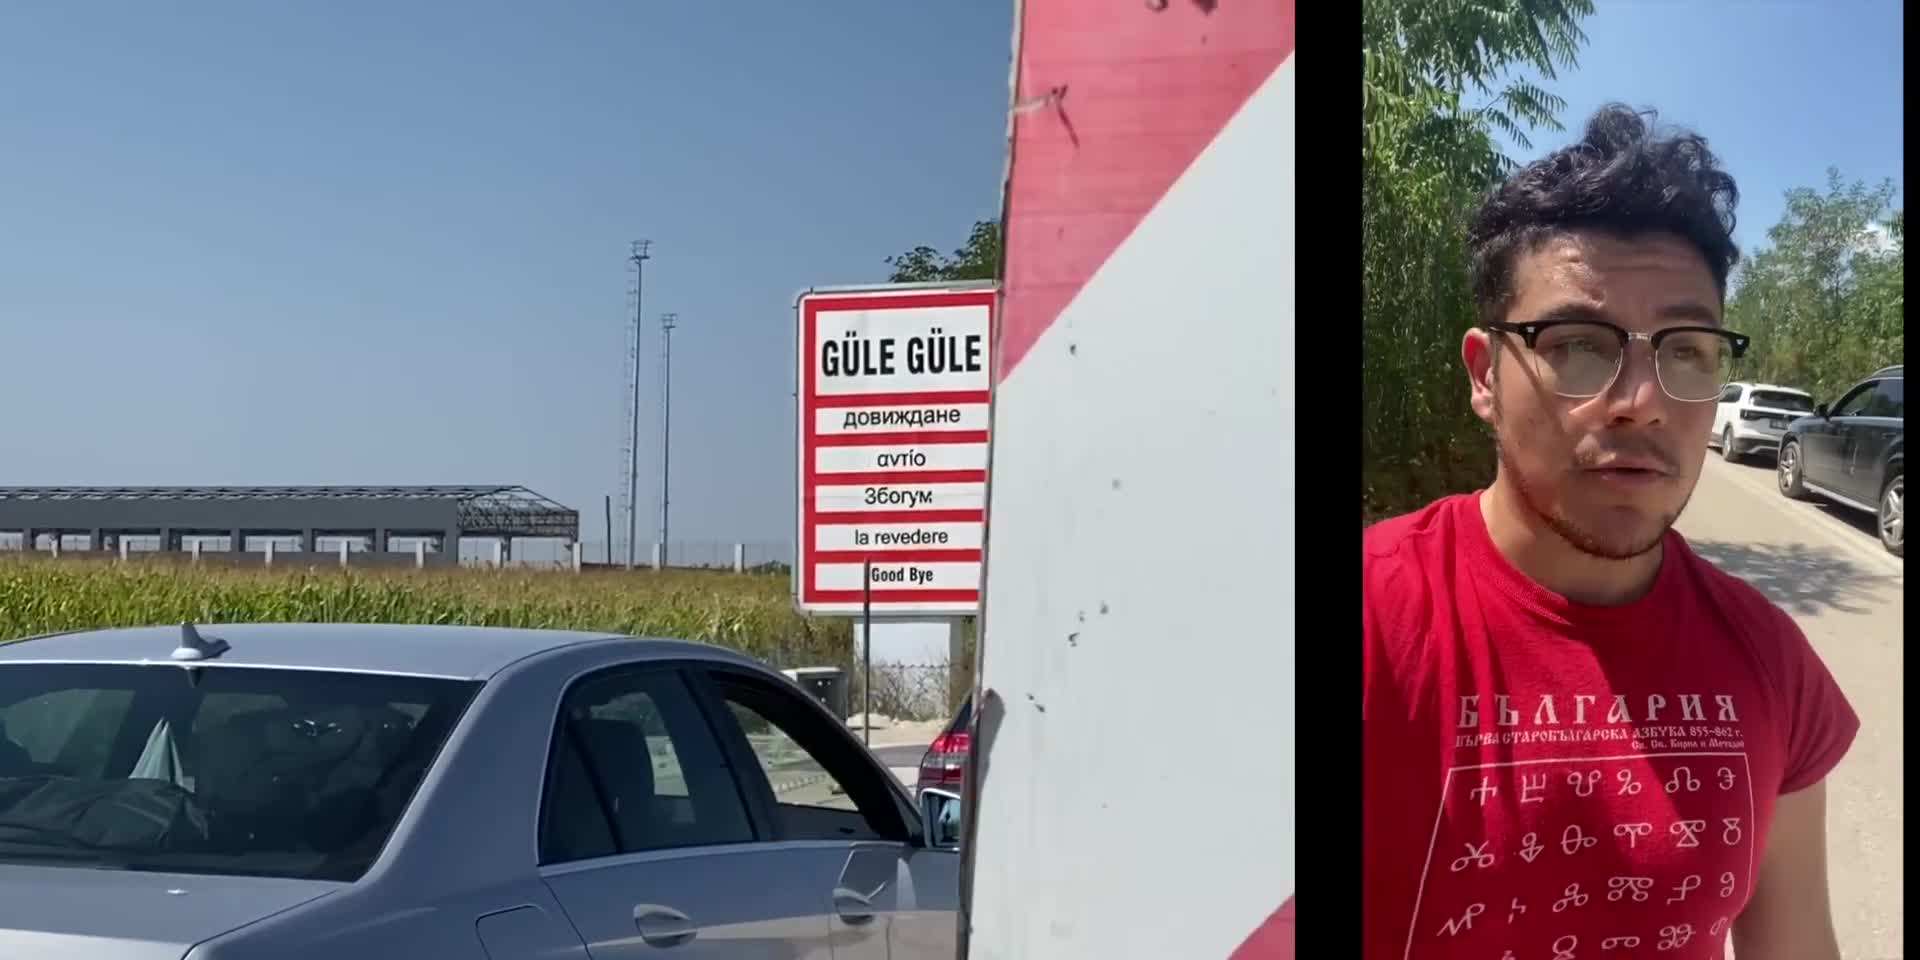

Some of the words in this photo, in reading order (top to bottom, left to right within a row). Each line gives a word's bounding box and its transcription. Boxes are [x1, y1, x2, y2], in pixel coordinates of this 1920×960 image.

[822, 330, 895, 377] GÜLE
[906, 327, 982, 374] GÜLE
[843, 408, 961, 429] довиждане
[877, 449, 926, 467] αντίο
[864, 486, 933, 508] Збогум
[855, 528, 869, 545] la
[875, 528, 949, 545] revedere
[871, 567, 904, 583] Good
[909, 566, 934, 585] Bye
[1456, 693, 1740, 728] БЪЛГАРИЯ
